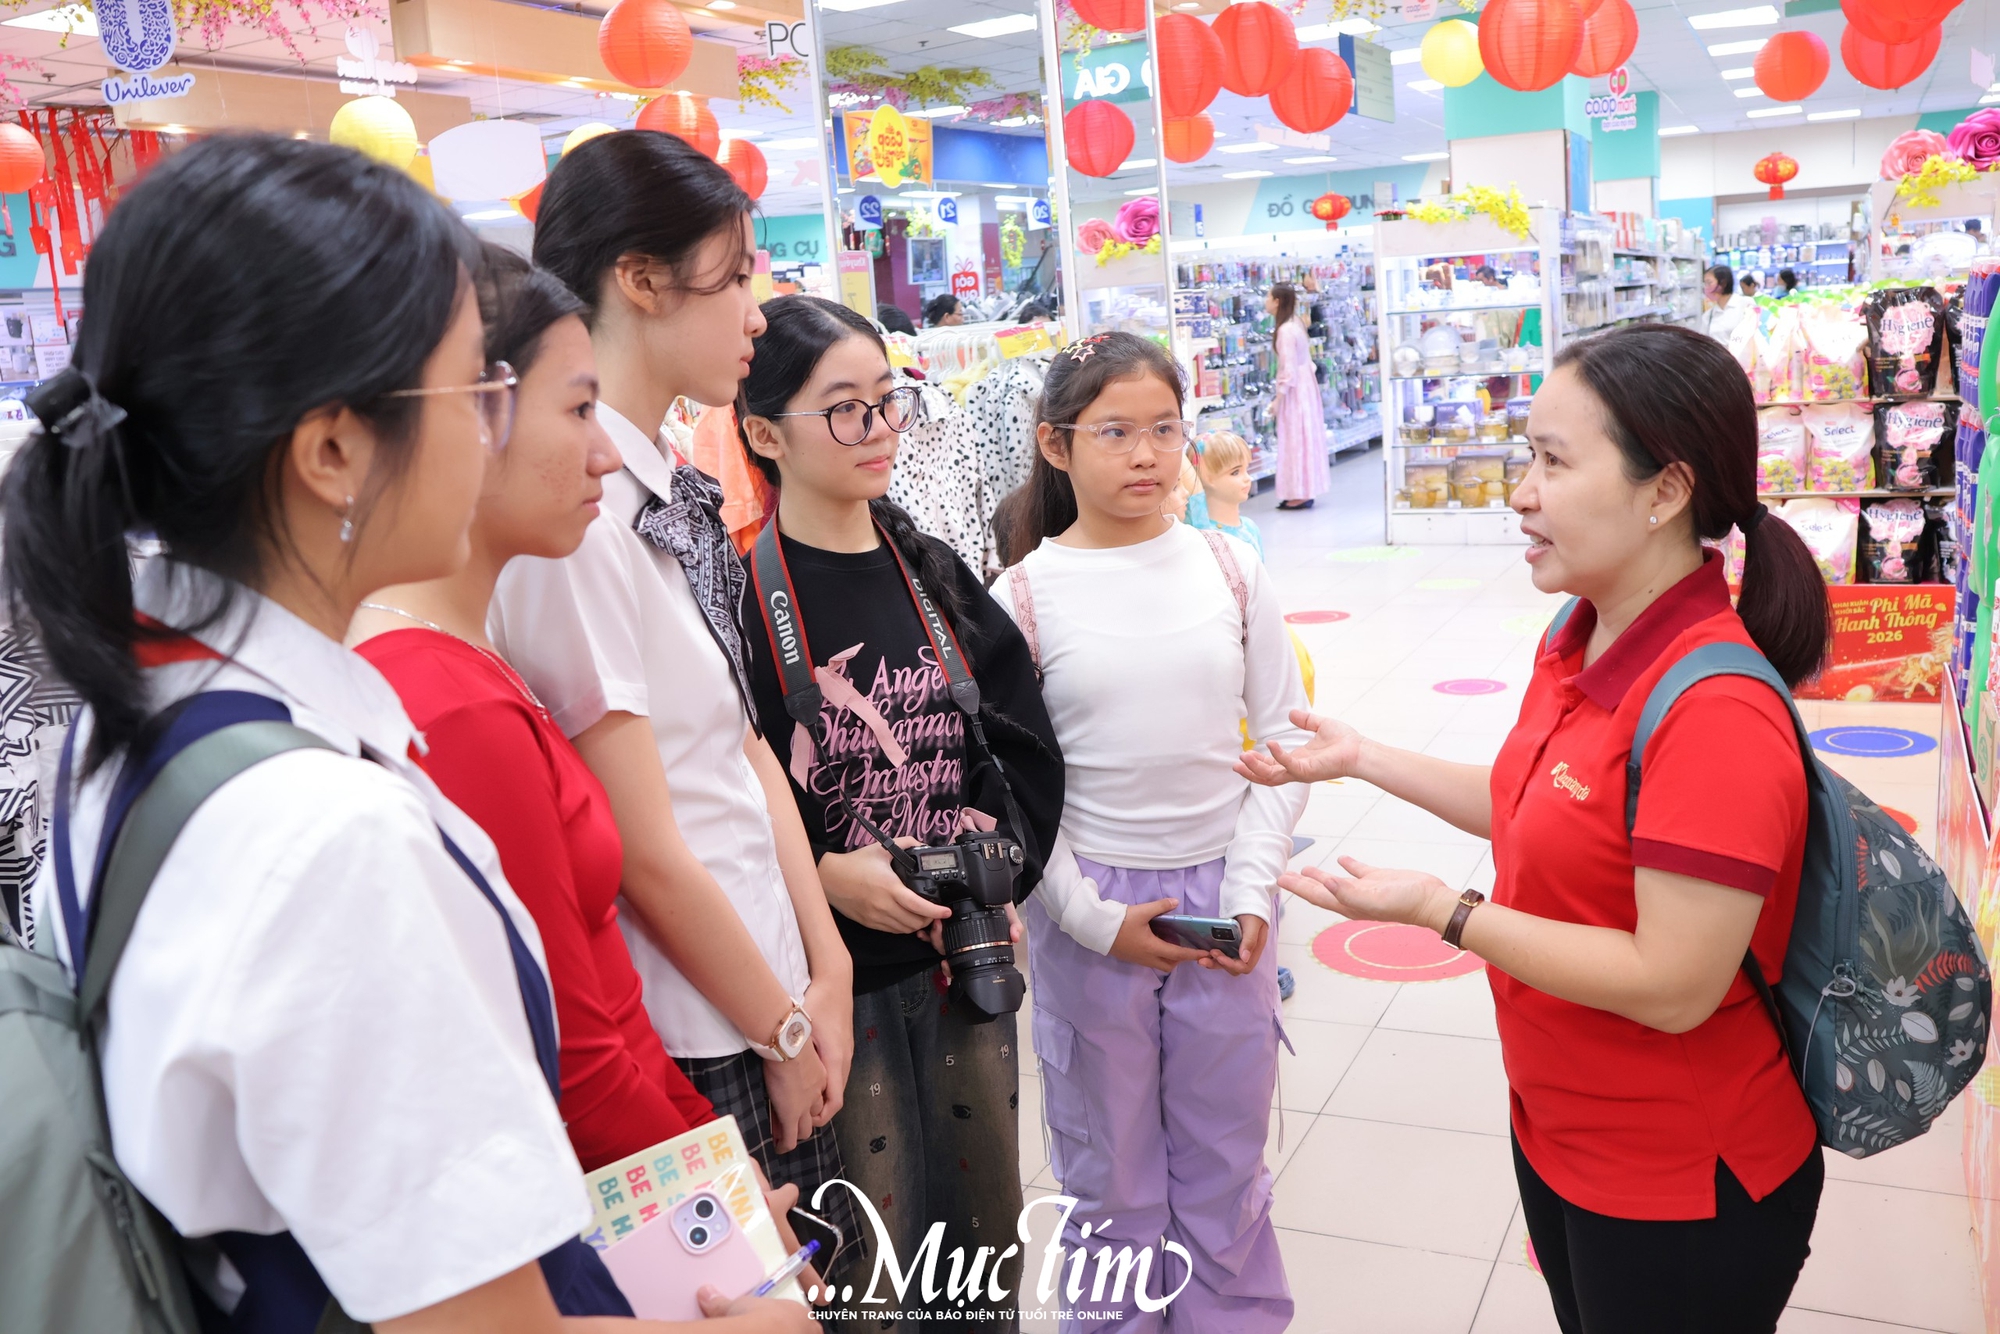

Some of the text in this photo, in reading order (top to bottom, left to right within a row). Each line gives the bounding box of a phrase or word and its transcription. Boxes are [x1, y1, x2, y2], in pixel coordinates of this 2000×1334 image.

[105, 76, 191, 102] Unilever
[1267, 193, 1294, 218] ĐỒ
[794, 240, 819, 259] CỤ
[1881, 316, 1933, 336] Hygiene
[1824, 425, 1856, 436] Select
[1886, 412, 1943, 429] Hygiene
[1869, 509, 1922, 521] Hygiene
[1870, 593, 1933, 614] Phi Mã
[770, 590, 801, 666] Canon
[912, 578, 952, 660] DIGITAL
[1834, 611, 1938, 633] Hanh Thông
[1866, 630, 1903, 644] 2026
[945, 1055, 954, 1066] 5
[1000, 1044, 1010, 1059] 19
[869, 1082, 881, 1097] 19
[681, 1142, 707, 1175] BE
[707, 1131, 734, 1165] BE
[653, 1153, 679, 1187] BE
[625, 1165, 652, 1199] BE
[597, 1177, 624, 1210] BE
[972, 1216, 980, 1228] 5
